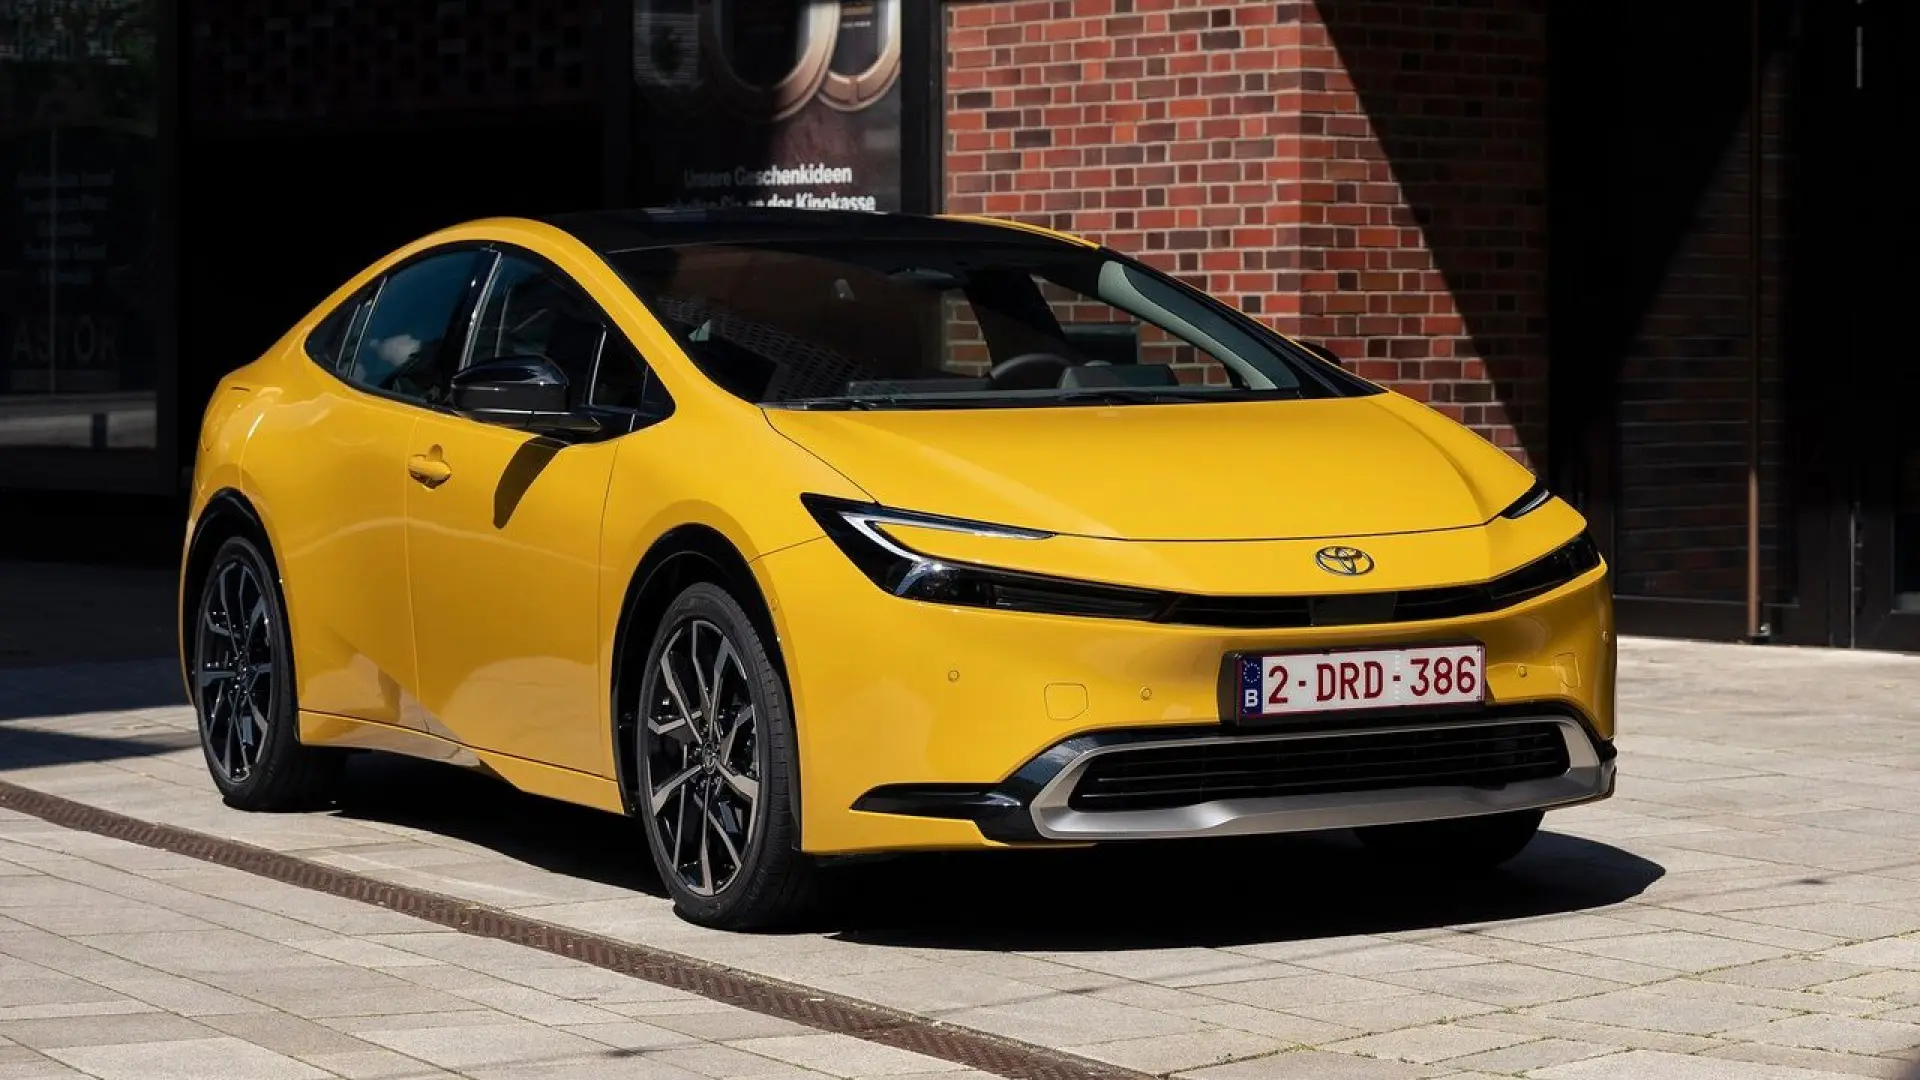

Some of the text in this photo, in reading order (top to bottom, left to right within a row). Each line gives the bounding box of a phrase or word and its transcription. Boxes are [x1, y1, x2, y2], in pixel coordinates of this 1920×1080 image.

[735, 163, 852, 188] Geschenkideen
[1268, 656, 1476, 705] 2-DRD-386
[1244, 689, 1259, 707] B
